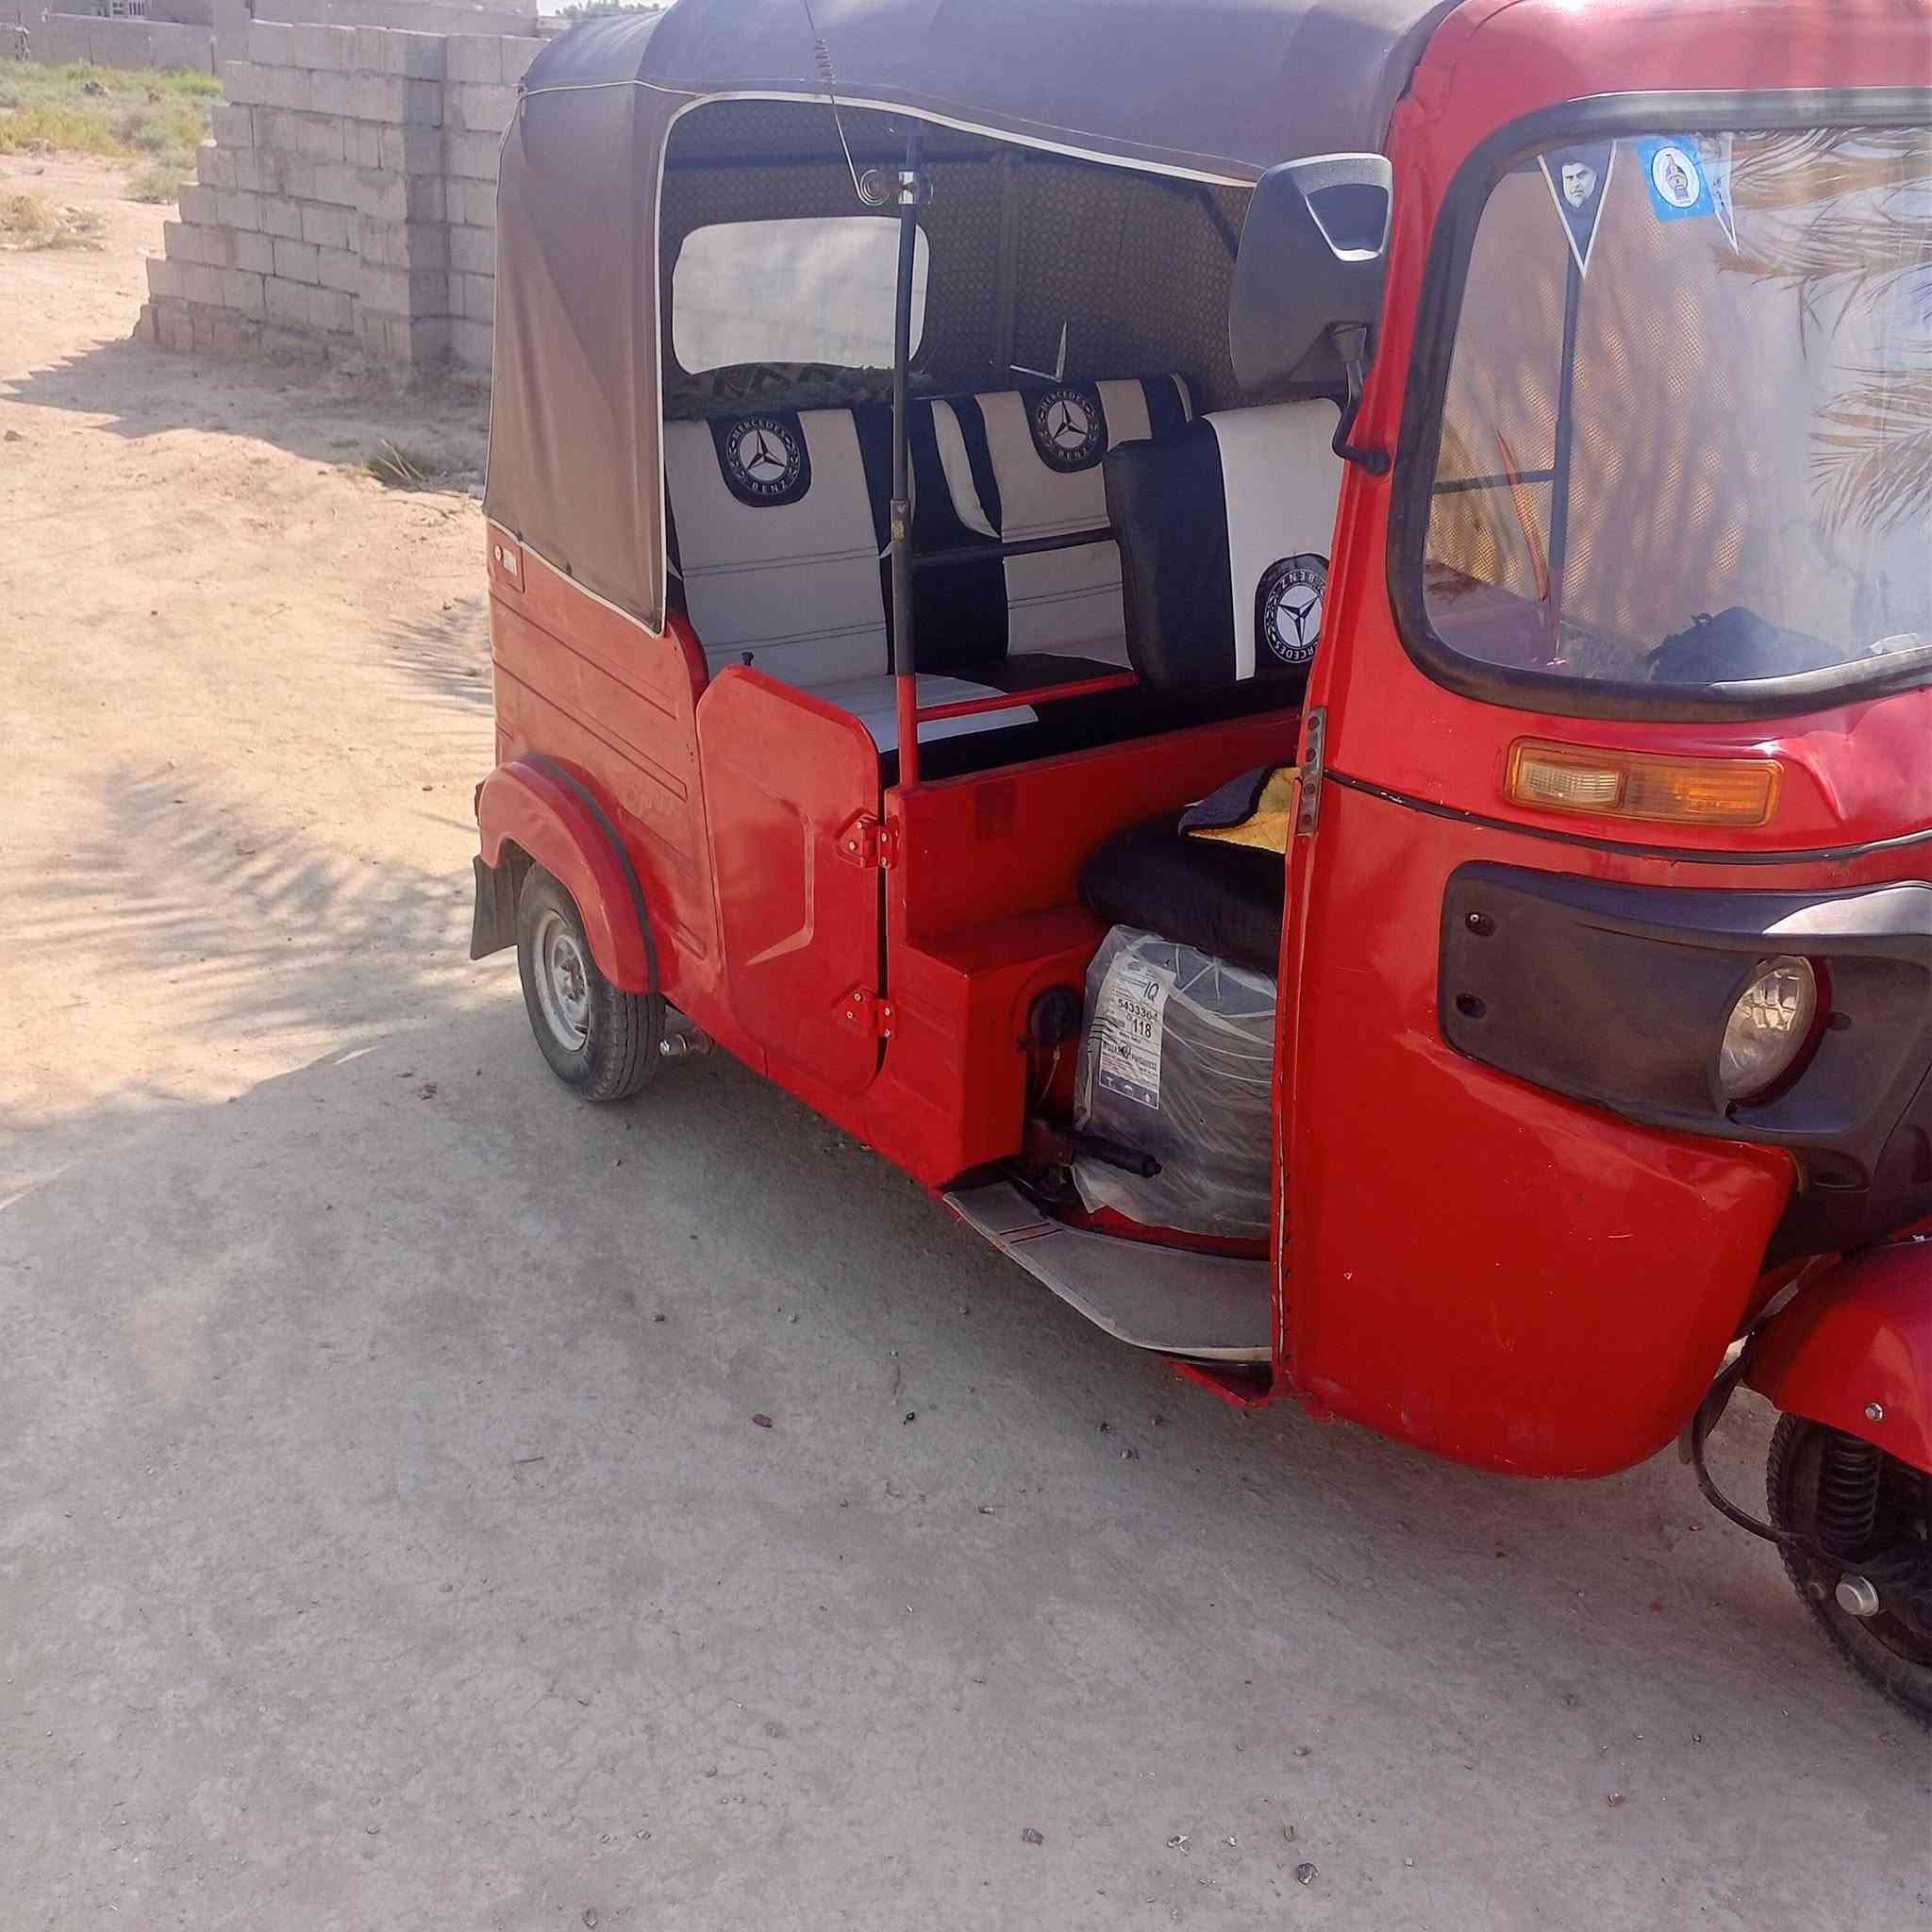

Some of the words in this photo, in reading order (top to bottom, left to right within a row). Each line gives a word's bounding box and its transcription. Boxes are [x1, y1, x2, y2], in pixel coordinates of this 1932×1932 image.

[1279, 571, 1315, 589] BENZ
[1274, 641, 1319, 660] RCEDES
[1133, 1018, 1152, 1039] 118
